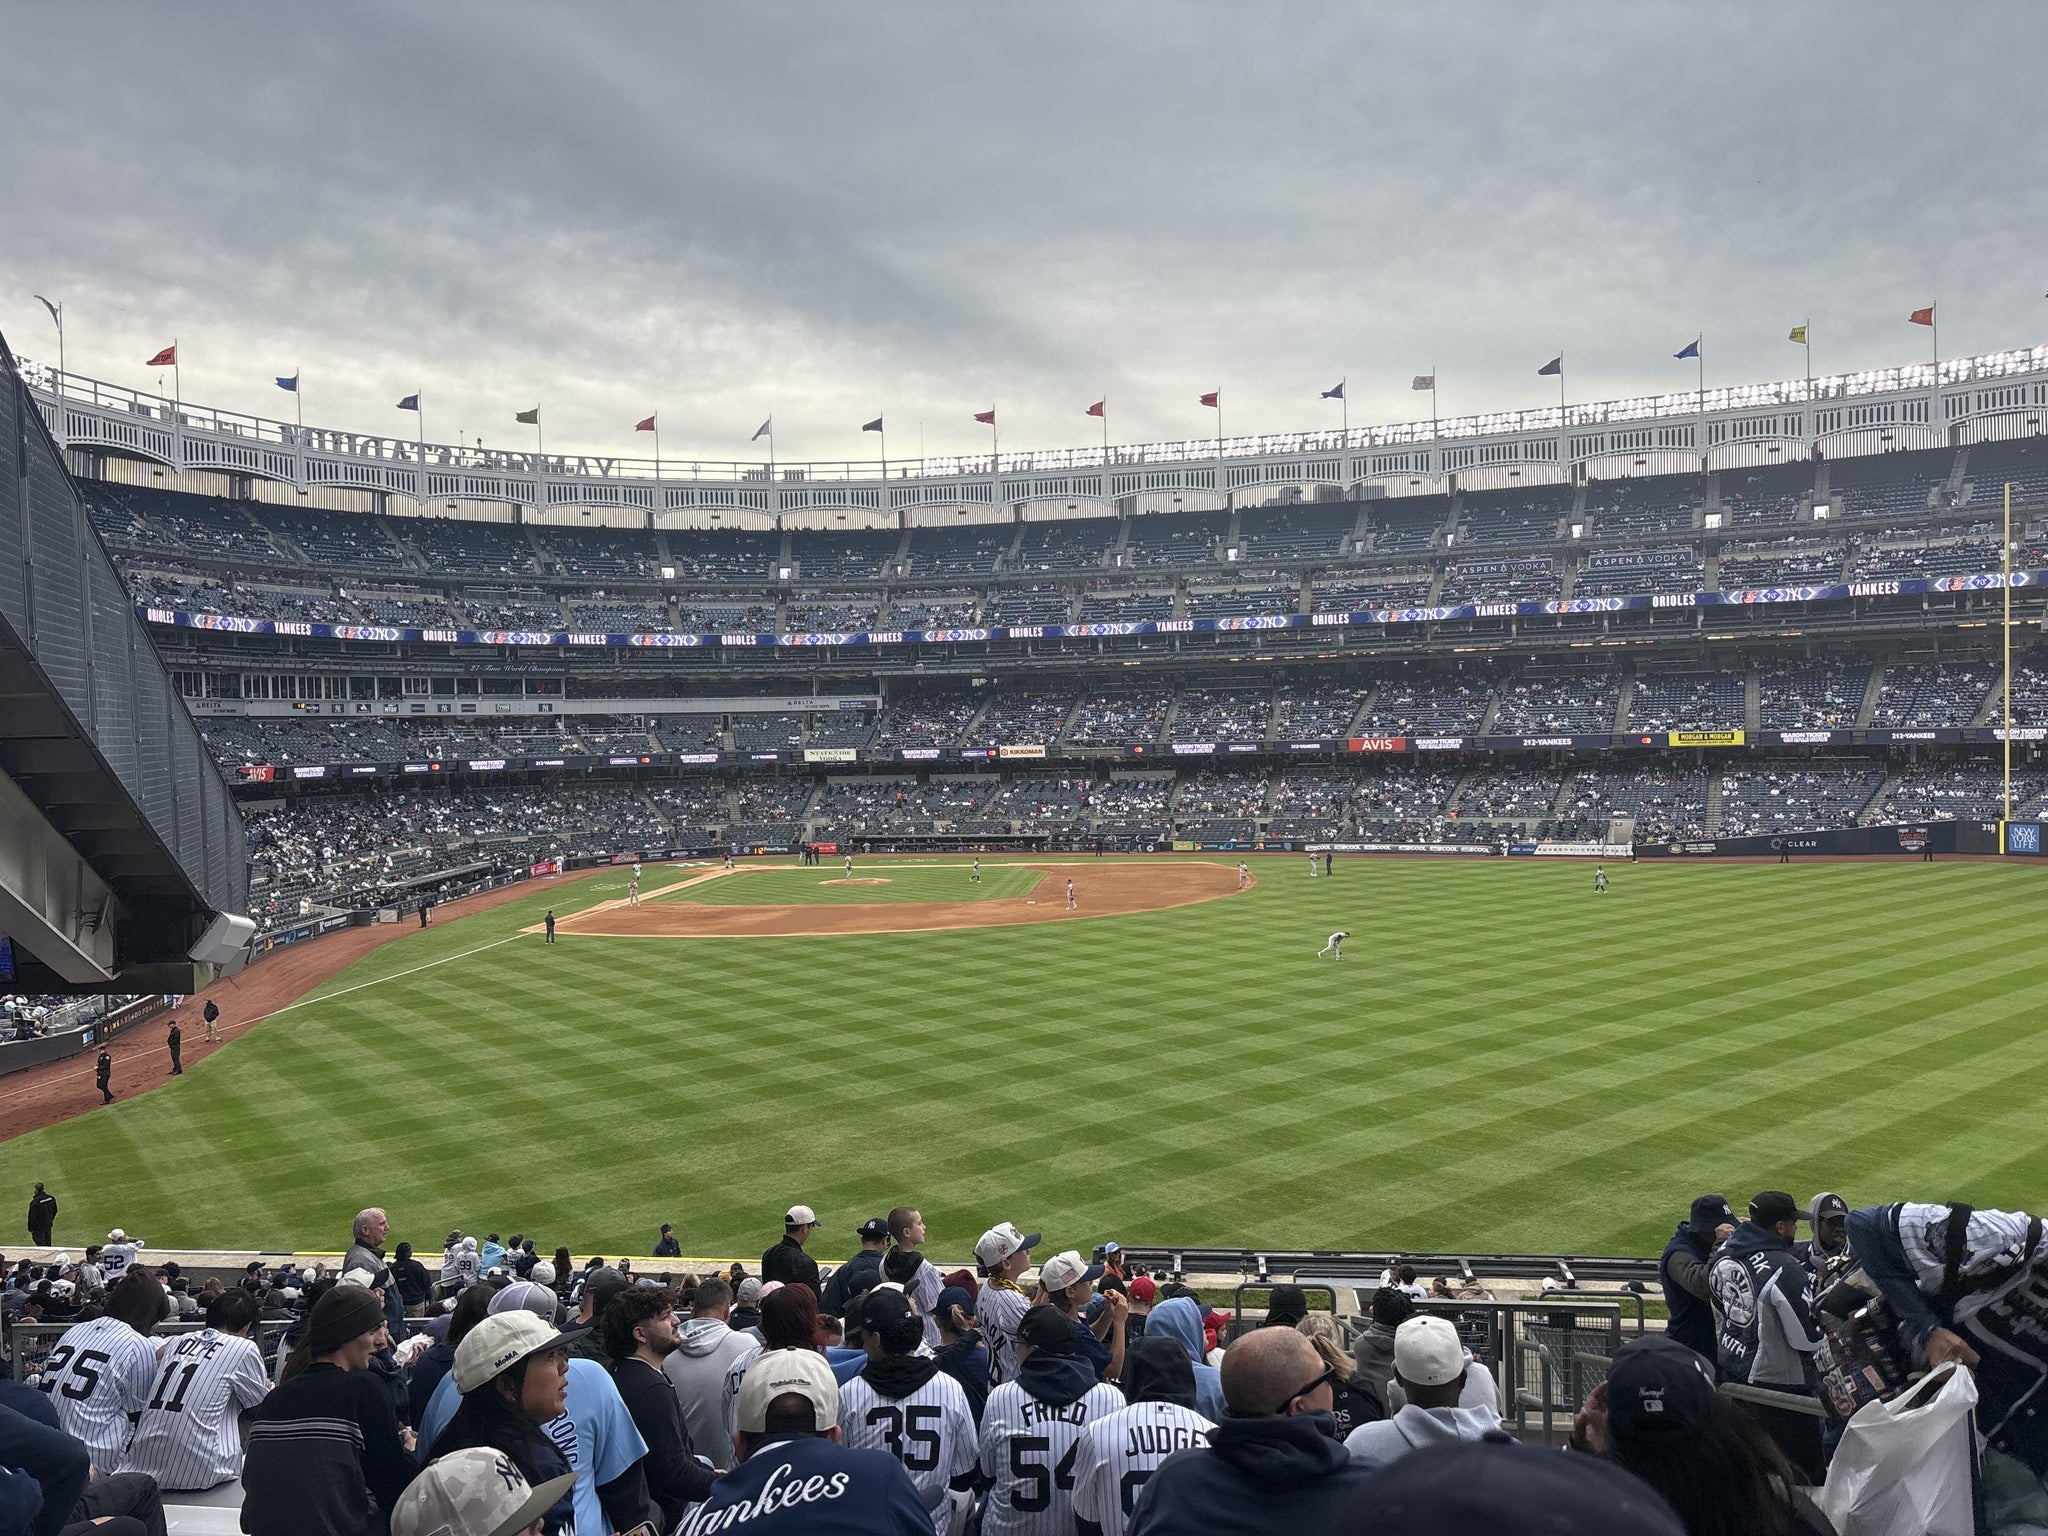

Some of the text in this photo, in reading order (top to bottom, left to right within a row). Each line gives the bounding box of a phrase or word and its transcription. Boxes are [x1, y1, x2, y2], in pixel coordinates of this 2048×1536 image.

[1595, 553, 1686, 566] ASPEN VODKA
[1462, 562, 1547, 574] ASPEN VODKA
[1848, 582, 1899, 596] YANKEES
[1652, 594, 1696, 607] ORIOLES
[147, 608, 175, 624] ORIOLES
[1474, 604, 1517, 616] YANKEES
[1312, 613, 1350, 625] ORIOLES
[274, 621, 311, 636] YANKEES
[1156, 620, 1194, 632] YANKEES
[422, 629, 457, 642] ORIOLES
[868, 632, 903, 643] YANKEES
[1009, 627, 1043, 638] ORIOLES
[567, 634, 606, 645] YANKEES
[721, 634, 757, 646] ORIOLES
[504, 664, 525, 673] World
[1523, 738, 1571, 746] 212-YANKEES
[1891, 732, 1936, 740] 212-YANKEES
[1362, 740, 1393, 750] AVIS
[248, 767, 267, 781] AVIS
[1982, 823, 1996, 831] 318
[2014, 827, 2035, 835] NEW
[2011, 833, 2036, 842] YORK
[1788, 840, 1817, 848] CLEAR
[2014, 841, 2034, 849] LIFE
[1831, 1198, 1842, 1208] NY
[868, 1221, 876, 1230] NY
[104, 1255, 125, 1271] 52
[460, 1261, 472, 1271] 99
[1748, 1251, 1772, 1275] RK
[1721, 1332, 1748, 1359] KITH
[494, 1350, 519, 1369] MoMA
[41, 1345, 111, 1401] 25
[149, 1360, 200, 1414] 11
[1020, 1401, 1088, 1427] FRIED
[866, 1405, 942, 1472] 35
[1125, 1425, 1207, 1458] JUDGE
[495, 1454, 523, 1492] NY
[674, 1462, 850, 1536] Yankees
